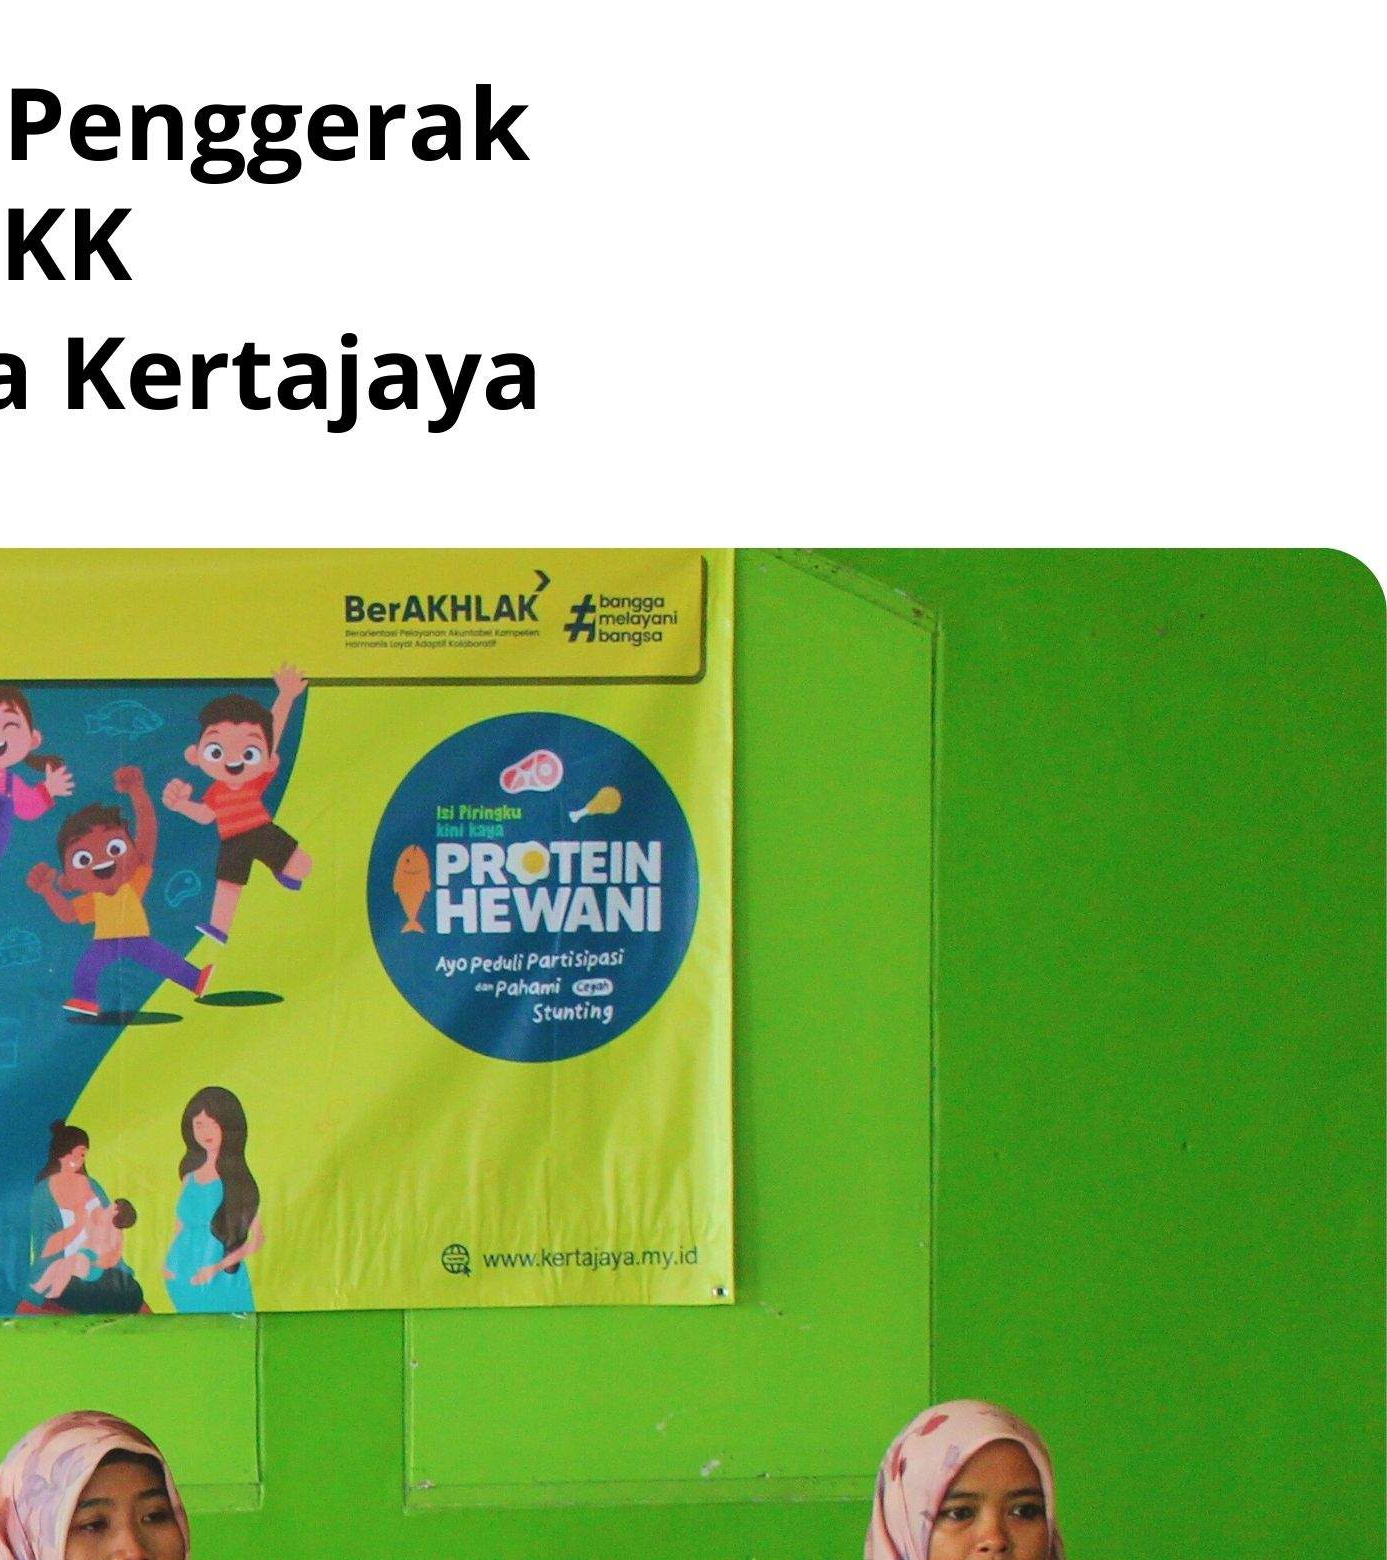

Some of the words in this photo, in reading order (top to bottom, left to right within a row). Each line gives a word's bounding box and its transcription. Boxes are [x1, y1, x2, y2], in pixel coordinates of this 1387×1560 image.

[344, 594, 540, 623] BerAKHLAK
[600, 594, 664, 612] bangga
[599, 611, 677, 628] melayani
[599, 629, 663, 646] bangsa
[437, 805, 454, 820] Isi
[459, 804, 522, 821] Piringku
[435, 840, 662, 886] PROTEIN
[436, 887, 662, 935] HEWANI
[436, 956, 468, 977] Ayo
[532, 1001, 613, 1024] Stunting
[483, 1246, 698, 1272] www.kertajaya.my.id
